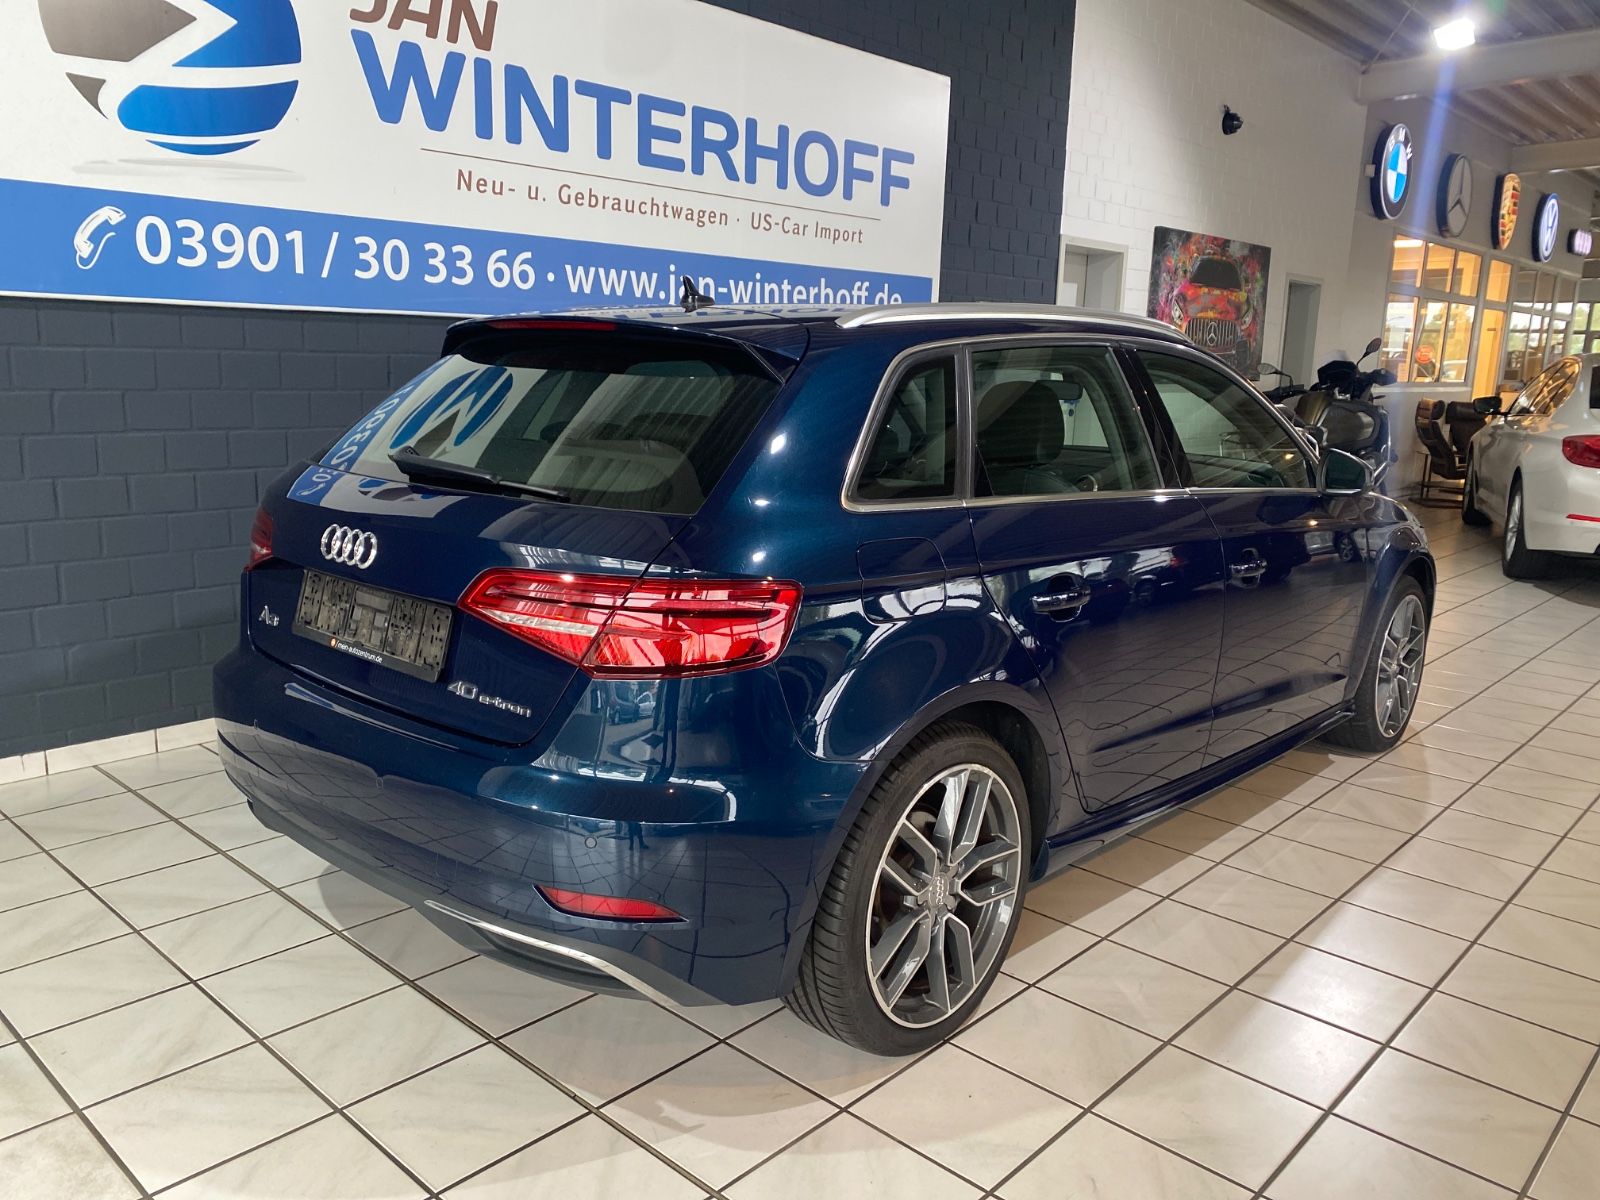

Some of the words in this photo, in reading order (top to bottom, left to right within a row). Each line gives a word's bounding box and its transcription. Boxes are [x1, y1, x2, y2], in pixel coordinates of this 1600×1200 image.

[350, 28, 916, 208] WINTERHOFF
[456, 168, 517, 196] Neu-
[527, 182, 548, 203] u.
[557, 182, 729, 228] Gebrauchtwagen
[750, 211, 809, 237] US-Car
[814, 220, 864, 245] Import
[135, 214, 305, 275] 03901
[353, 235, 411, 282] 30
[423, 241, 474, 284] 33
[485, 249, 536, 289] 66
[564, 262, 903, 306] www.jn-winterhoffde
[447, 680, 478, 700] 40
[479, 695, 532, 718] e-tron
